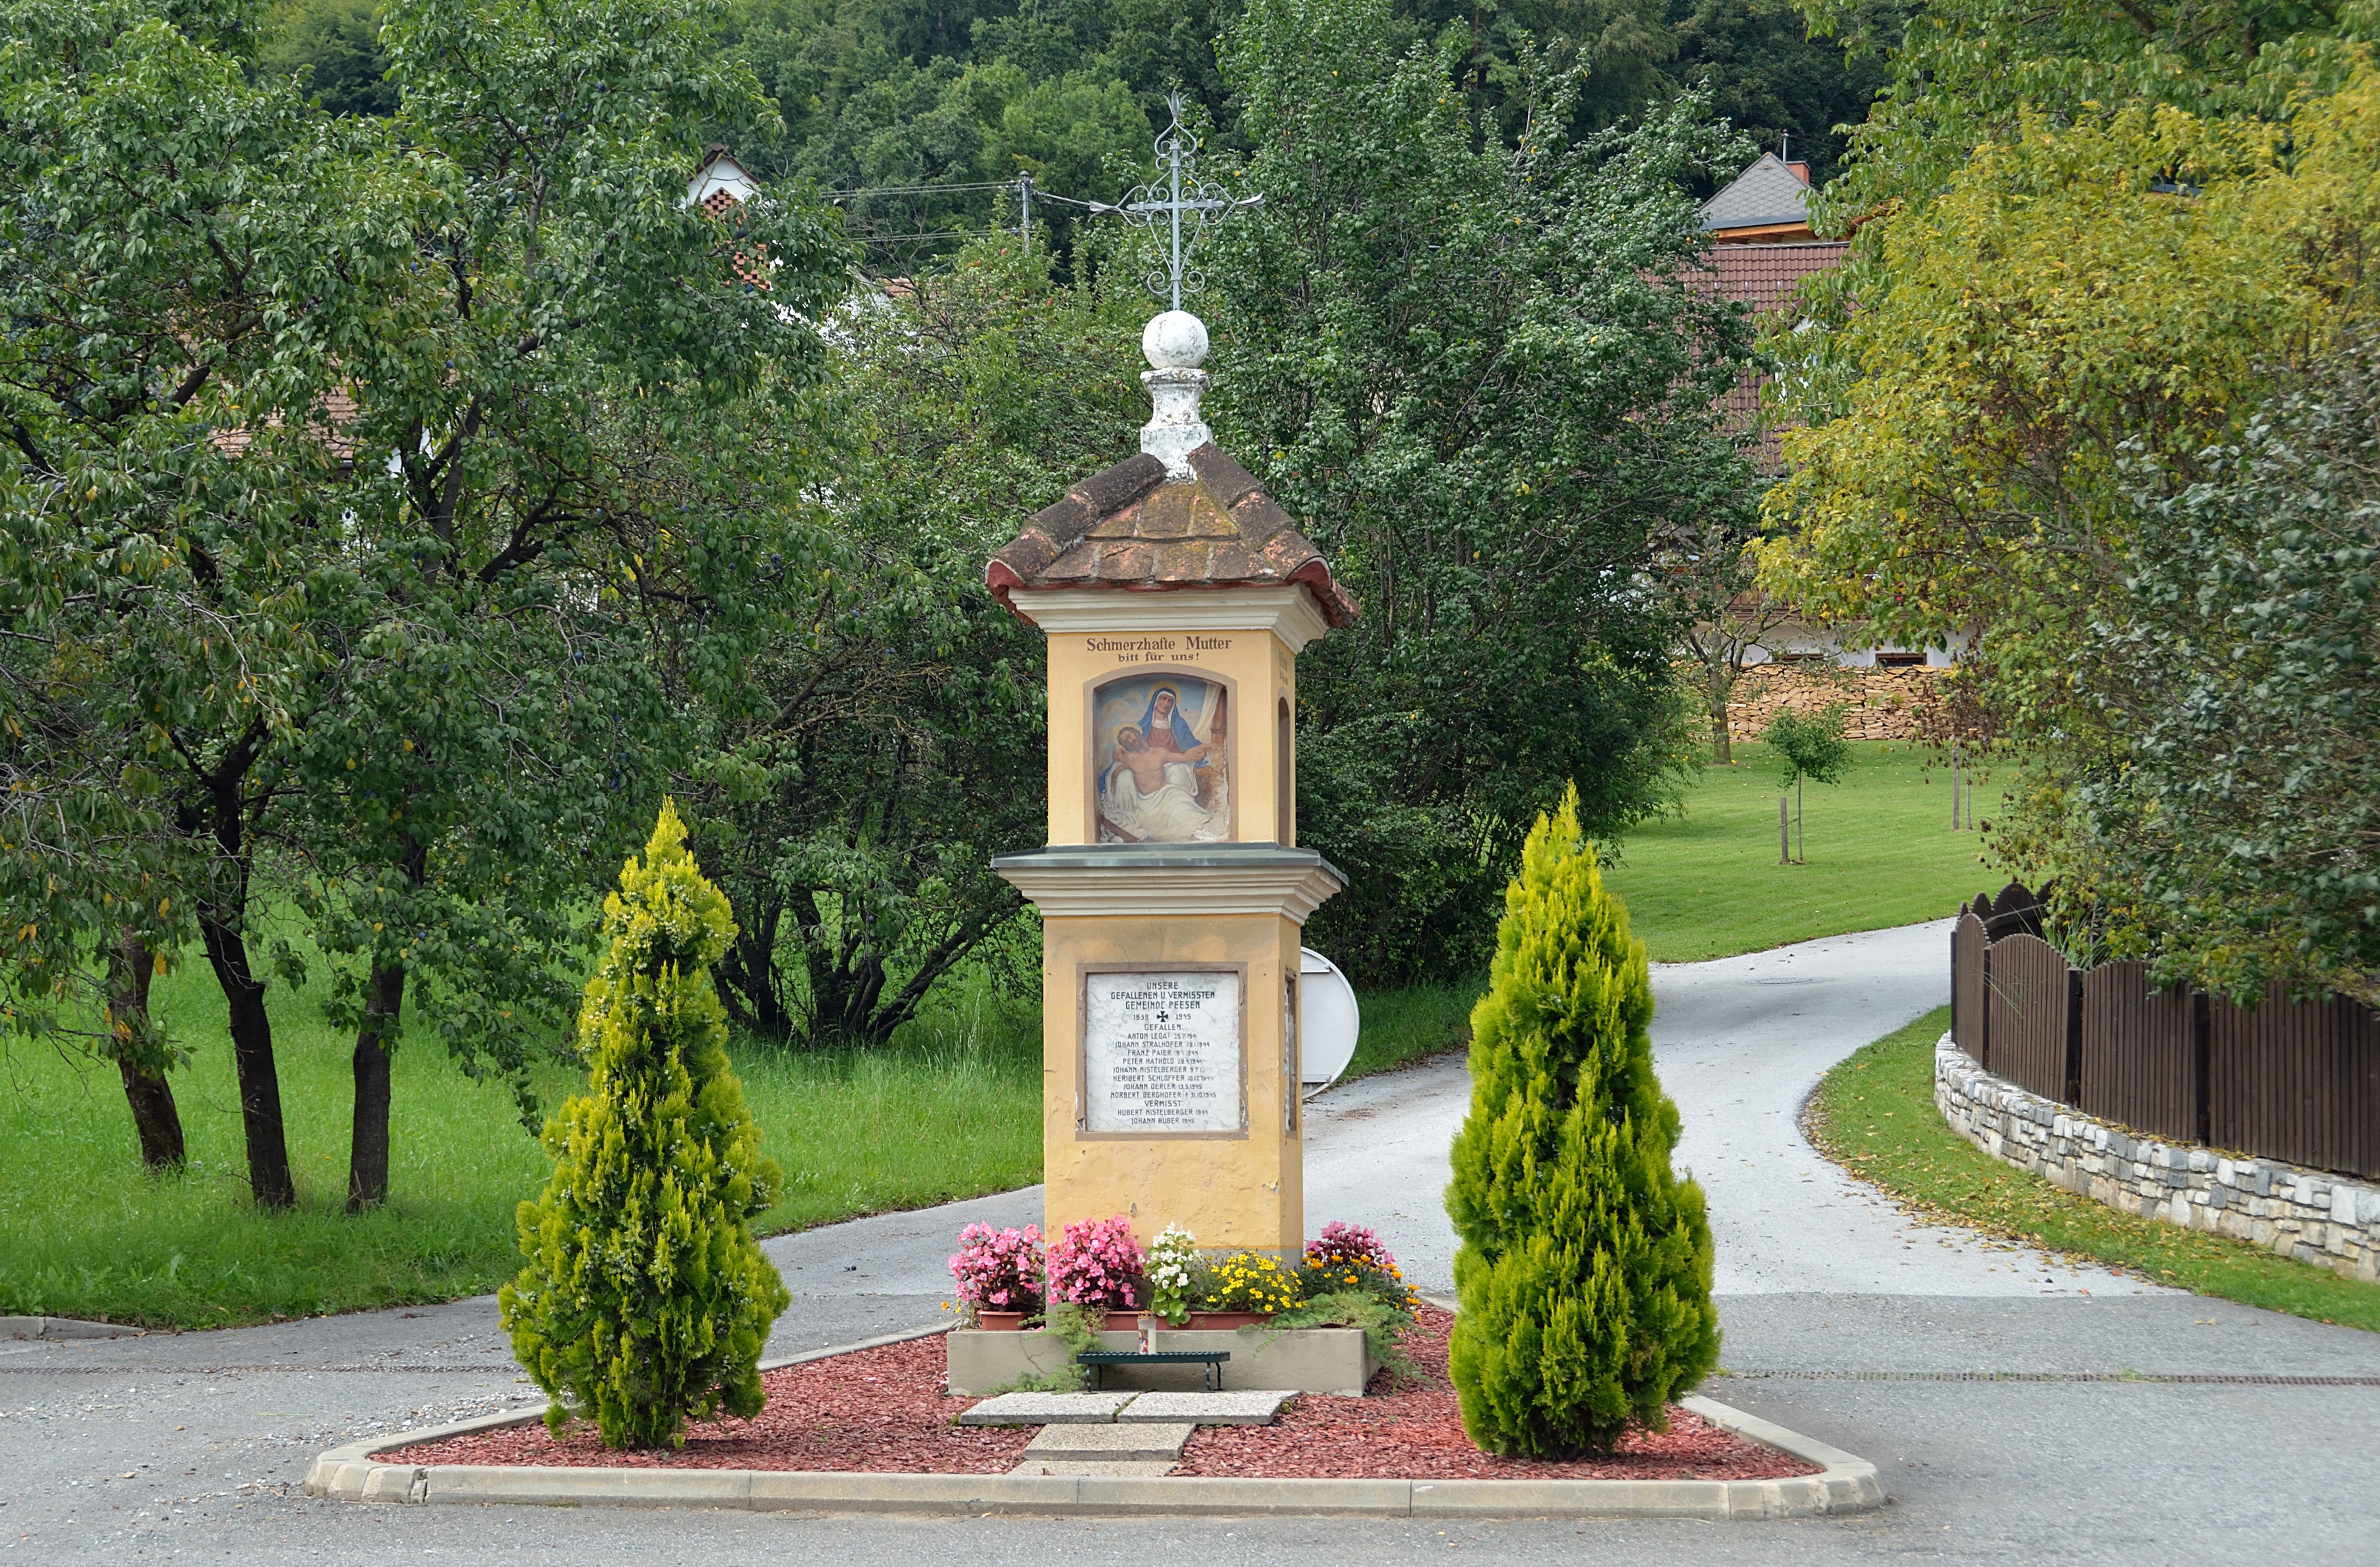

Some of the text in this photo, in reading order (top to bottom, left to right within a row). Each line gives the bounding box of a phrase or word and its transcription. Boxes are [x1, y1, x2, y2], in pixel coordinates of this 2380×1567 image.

[1087, 636, 1232, 652] Schmerzhafte Mutter
[1118, 651, 1200, 662] bitt für uns!
[1110, 991, 1215, 1000] GEFALLENEN U. VERMISSTEN
[1126, 1001, 1200, 1009] GEMEINDE PEESEN
